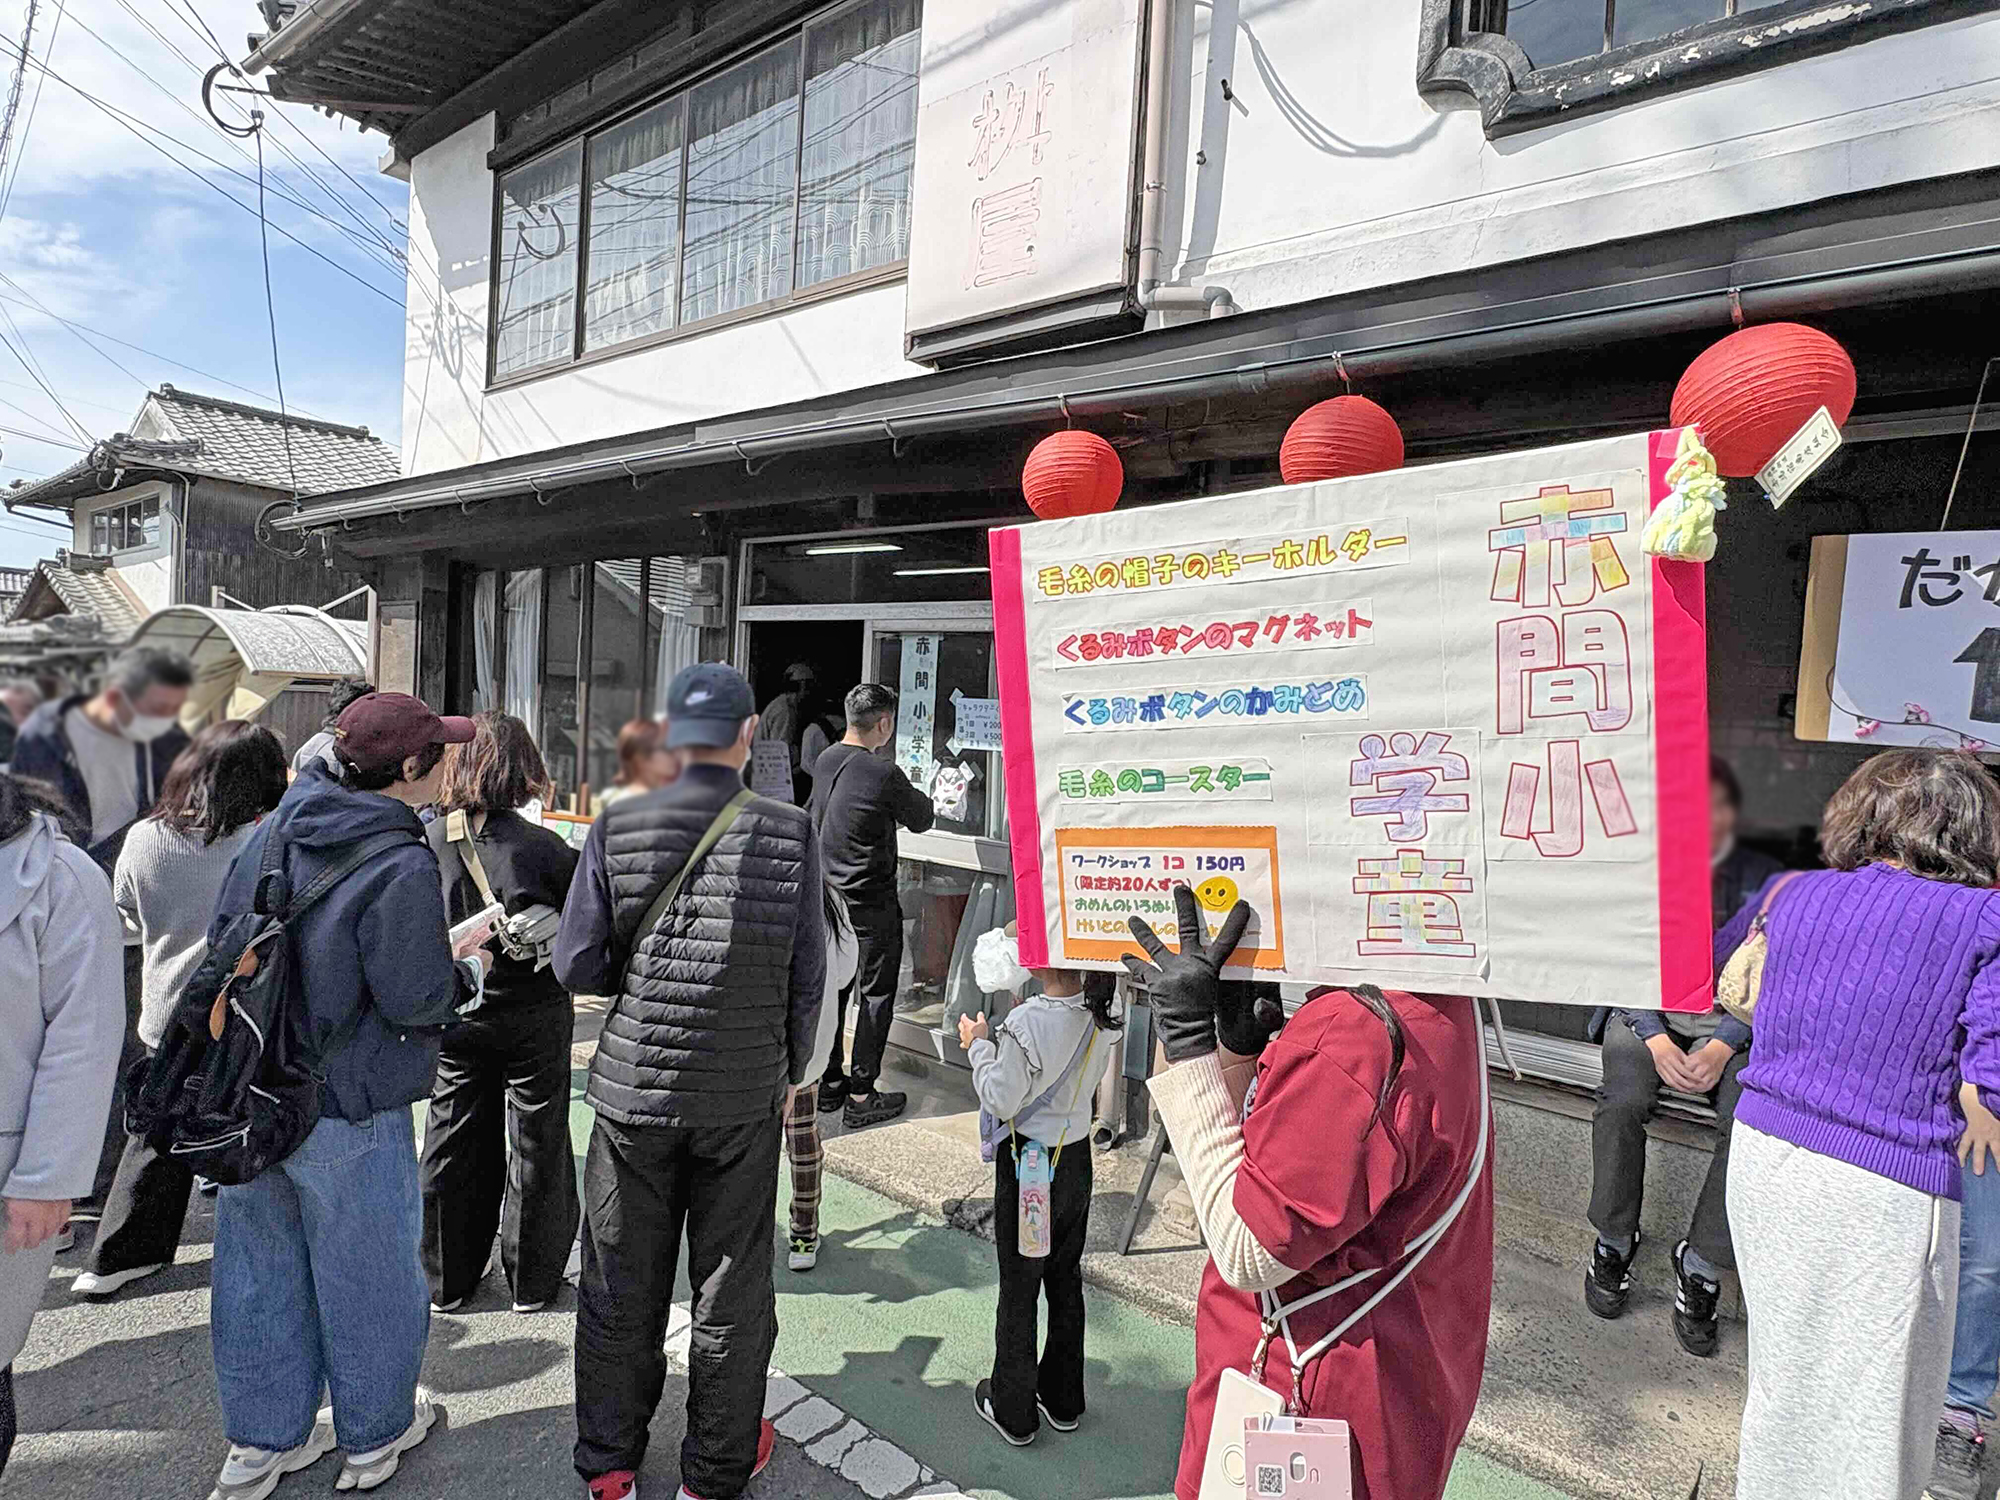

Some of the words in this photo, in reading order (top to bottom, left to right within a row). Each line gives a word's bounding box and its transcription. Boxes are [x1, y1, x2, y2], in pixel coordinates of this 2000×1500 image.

[1038, 530, 1406, 596] 毛糸の帽子のキーホルダー
[1057, 609, 1373, 662] くるみボタンのマグネット
[1489, 485, 1638, 857] 赤間小
[909, 636, 931, 784] 赤間小学童
[1064, 678, 1366, 726] くるみボタンのかみとめ
[1058, 765, 1271, 798] 毛糸のコースター
[1163, 855, 1184, 870] 1コ
[1196, 856, 1245, 871] 150円
[1350, 732, 1477, 957] 学童
